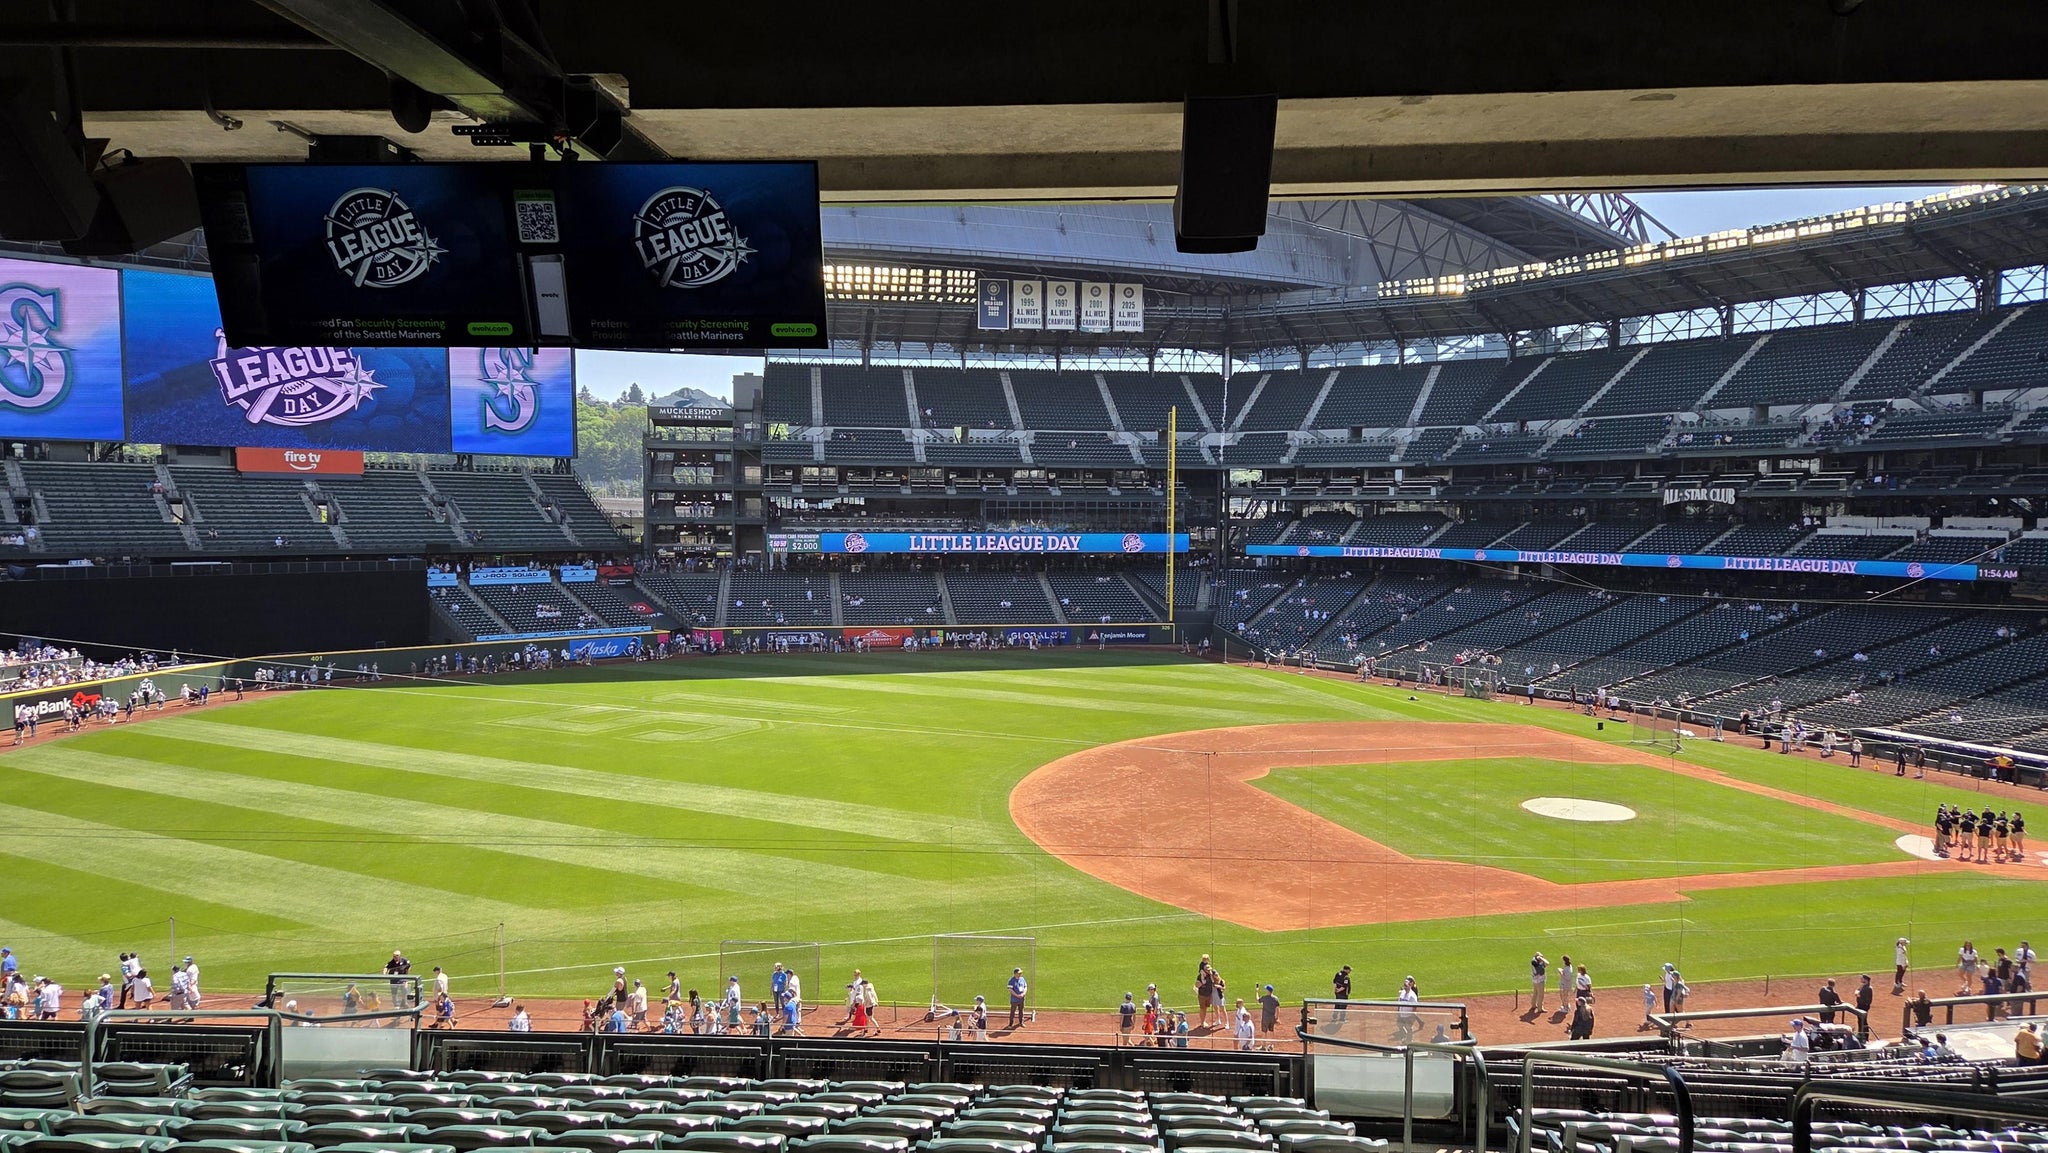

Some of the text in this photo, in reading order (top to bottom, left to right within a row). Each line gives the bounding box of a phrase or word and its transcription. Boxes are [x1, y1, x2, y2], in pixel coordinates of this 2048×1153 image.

[341, 198, 383, 222] LITTLE
[650, 197, 695, 222] LITTLE
[327, 212, 422, 269] LEAGUE
[635, 211, 733, 269] LEAGUE
[376, 260, 403, 279] DAY
[682, 259, 711, 279] DAY
[1020, 298, 1035, 307] 1995
[1055, 299, 1068, 308] 1997
[1089, 300, 1103, 309] 2001
[1121, 301, 1136, 310] 2025
[336, 319, 354, 328] Fan
[354, 319, 396, 330] Security
[397, 319, 446, 330] Screening
[700, 320, 749, 330] Screening
[1014, 317, 1041, 325] CHAMPIONS
[1048, 318, 1075, 326] CHAMPIONS
[1082, 319, 1109, 327] CHAMPIONS
[1115, 320, 1141, 328] CHAMPIONS
[333, 330, 343, 340] of
[345, 330, 361, 340] the
[363, 330, 397, 340] Seattle
[399, 330, 441, 340] Mariners
[701, 331, 744, 341] Mariners
[775, 326, 814, 335] evolv.com
[216, 346, 355, 399] LEAGUE
[284, 392, 323, 414] DAY
[659, 408, 723, 416] MUCKLESHOOT
[284, 451, 321, 463] fire tv
[1709, 488, 1736, 505] CLUB
[909, 535, 1082, 551] LITTLE LEAGUE DAY
[1343, 547, 1441, 559] LITTLE LEAGUE DAY
[1519, 552, 1623, 565] LITTLE LEAGUE DAY
[1724, 557, 1858, 573] LITTLE LEAGUE DAY
[1979, 569, 2018, 578] 11:54 AM
[573, 642, 618, 656] Alaska
[15, 698, 71, 718] KeyBank
